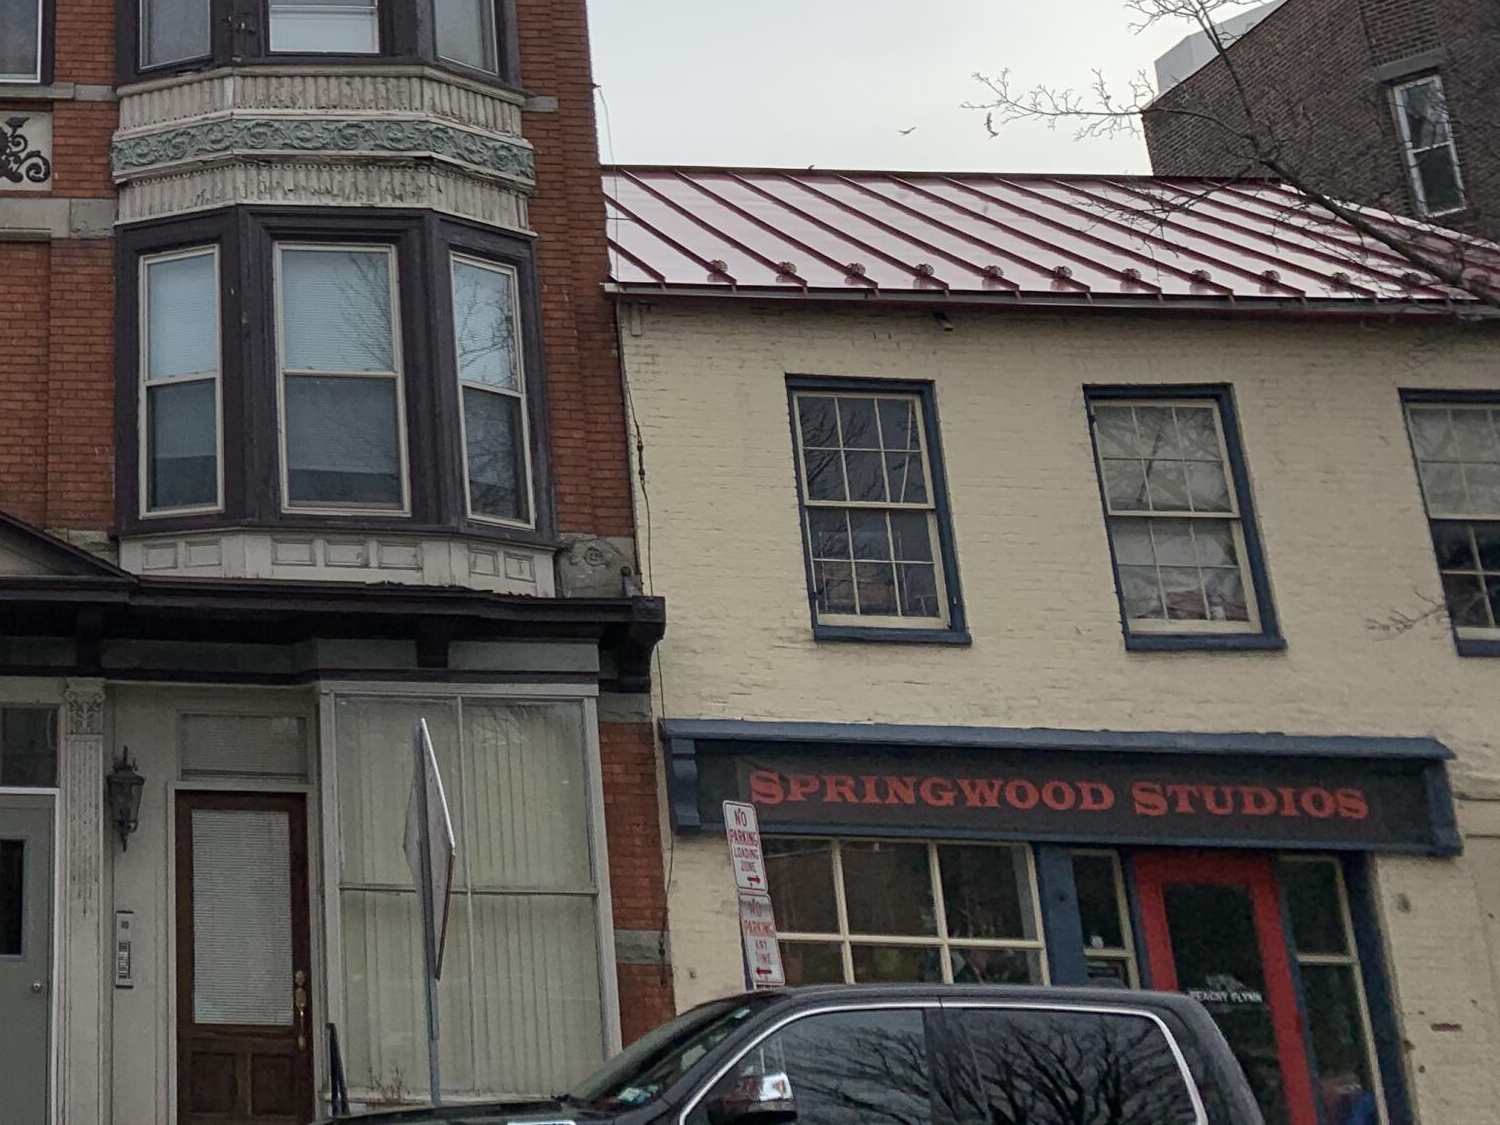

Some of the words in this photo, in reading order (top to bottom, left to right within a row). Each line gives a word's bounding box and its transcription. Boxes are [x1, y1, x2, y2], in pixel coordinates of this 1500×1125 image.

[749, 769, 1116, 811] SPRINGWOOD
[1131, 780, 1369, 819] STUDIOS
[733, 809, 748, 827] NO
[728, 828, 759, 847] PARKING
[743, 920, 775, 937] PARKING
